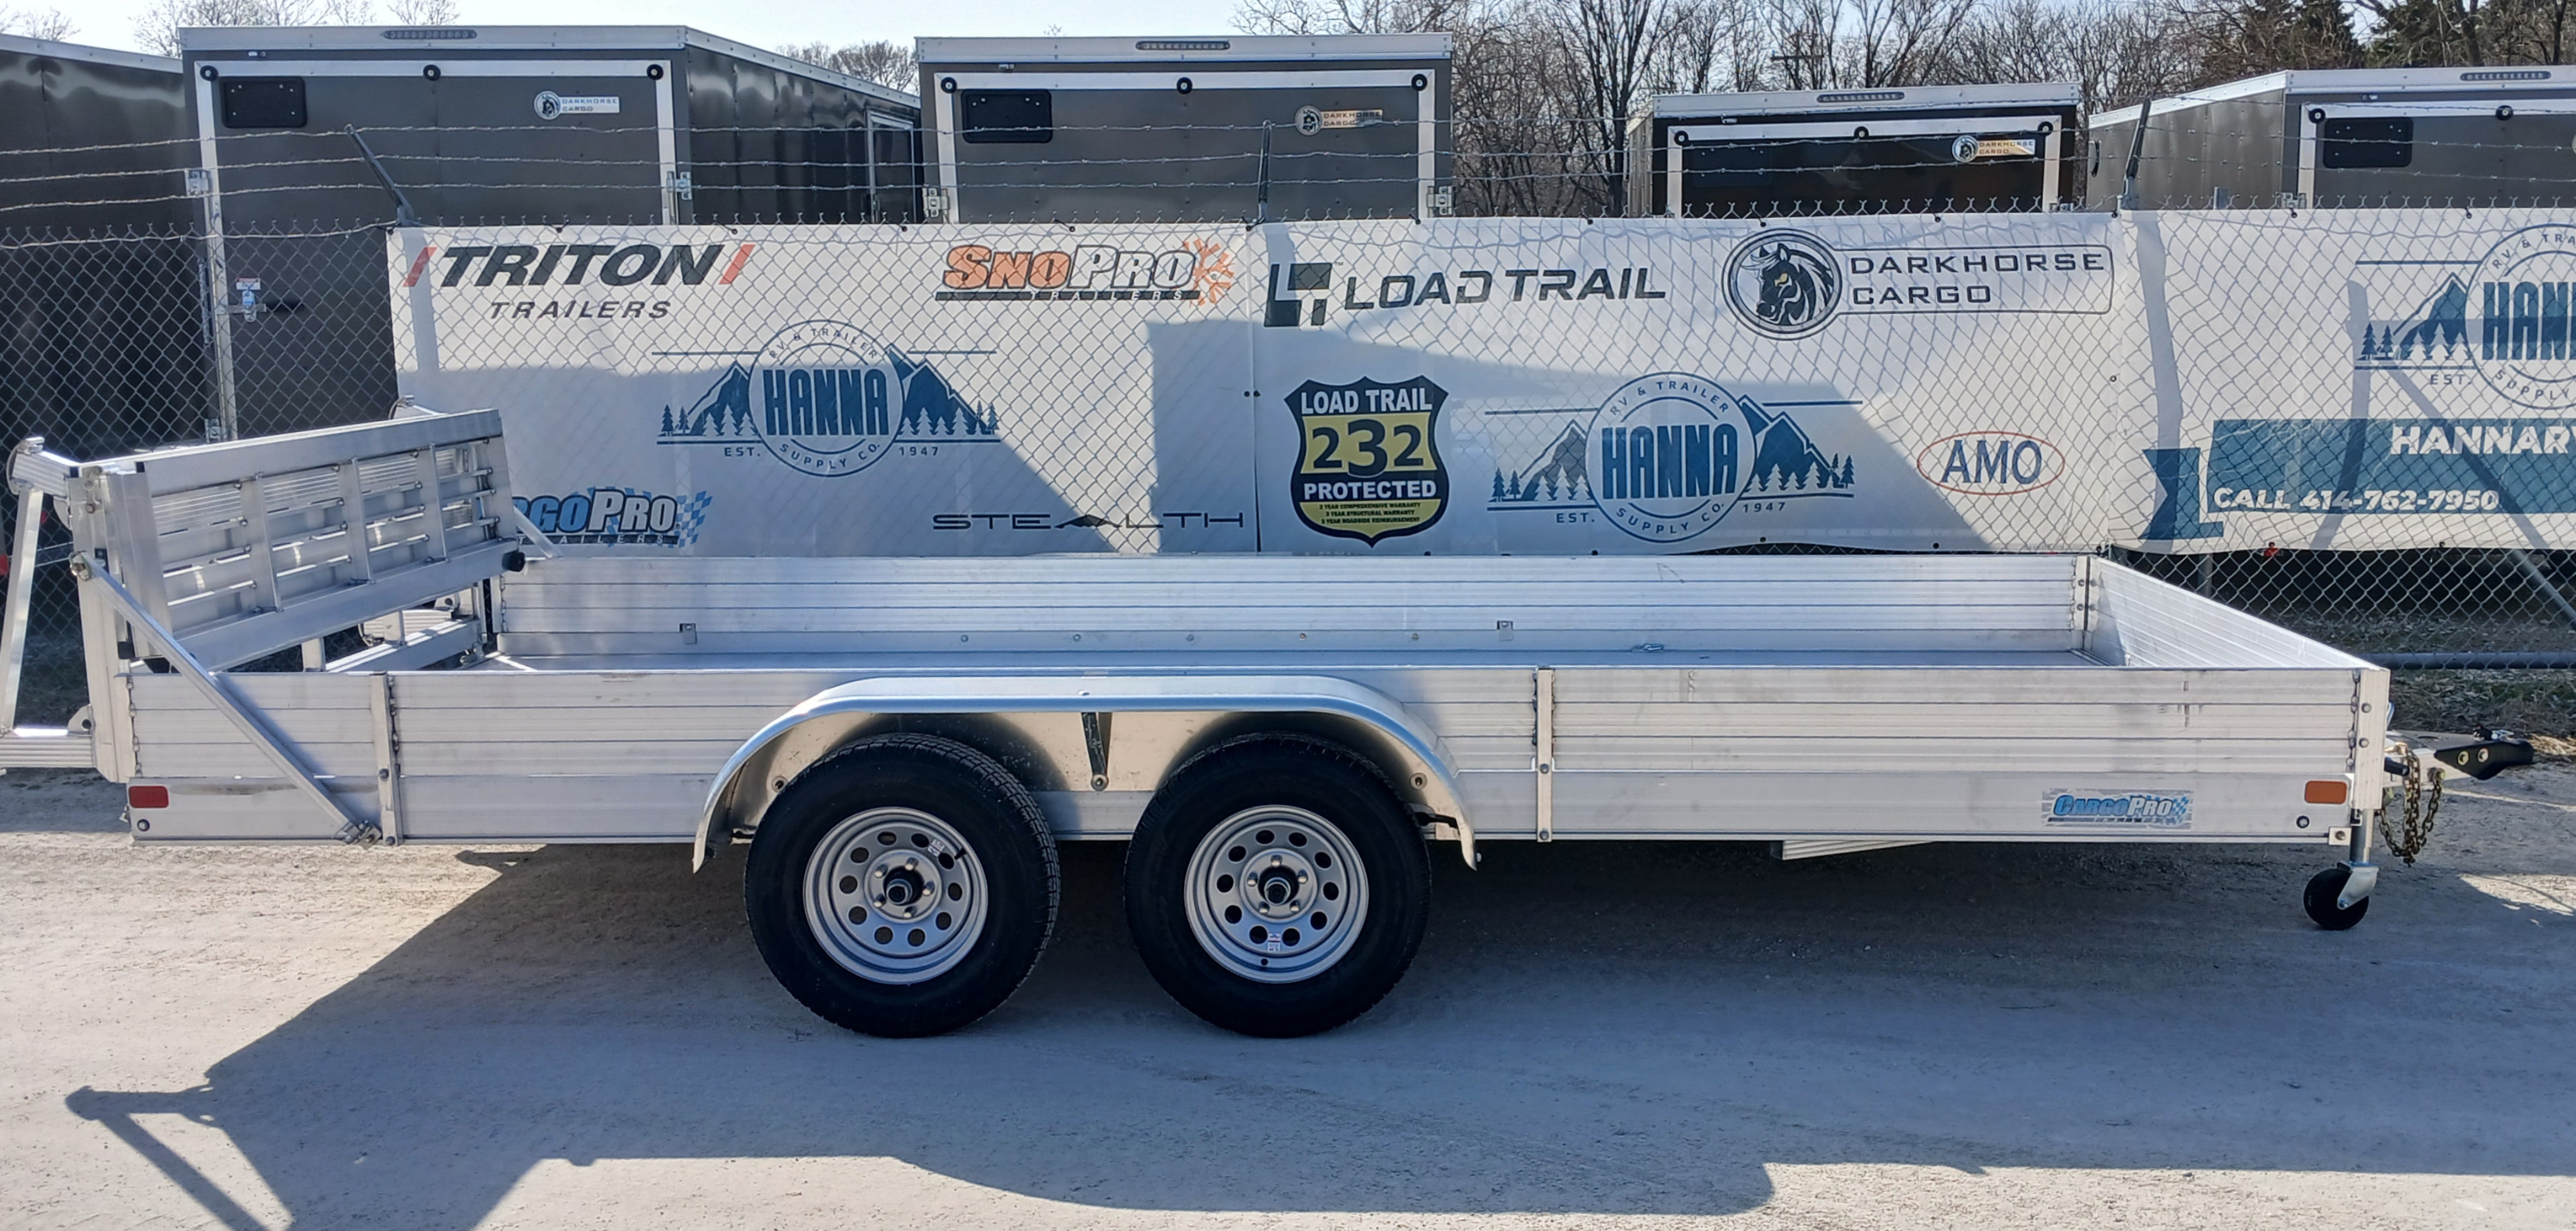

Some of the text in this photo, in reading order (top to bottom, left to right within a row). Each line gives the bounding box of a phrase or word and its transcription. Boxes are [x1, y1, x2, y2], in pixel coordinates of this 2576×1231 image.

[440, 244, 725, 287] TRITON
[1851, 253, 2104, 274] DARKHORSE
[2492, 249, 2511, 269] RV
[2522, 239, 2531, 248] &
[1030, 291, 1183, 301] TRAILERS
[1344, 268, 1666, 310] LOAD TRAIL
[1853, 286, 1991, 304] CARGO
[490, 300, 671, 319] TRAILERS
[2482, 281, 2576, 361] HAN
[769, 342, 785, 359] RV
[810, 329, 877, 359] TRAILER
[2430, 374, 2471, 385] EST.
[2495, 369, 2570, 400] SUPPLY
[762, 369, 889, 436] HANNA
[1301, 388, 1432, 414] LOAD TRAIL
[1610, 381, 1729, 416] RV & TRAILER
[725, 447, 761, 457] EST.
[899, 446, 938, 456] 1947
[1313, 419, 1423, 477] 232
[2390, 426, 2576, 454] HANNAR
[779, 443, 880, 469] SUPPLY CO.
[1601, 424, 1738, 499] HANNA
[1940, 439, 2042, 485] AMO
[1304, 480, 1436, 500] PROTECTED
[2213, 488, 2500, 511] CALL 414-762-7950
[1556, 513, 1595, 523] EST.
[1616, 503, 1724, 534] SUPPLY CO.
[1742, 502, 1786, 513] 1947
[933, 513, 1243, 529] STEALTH
[519, 536, 663, 545] TAILERS
